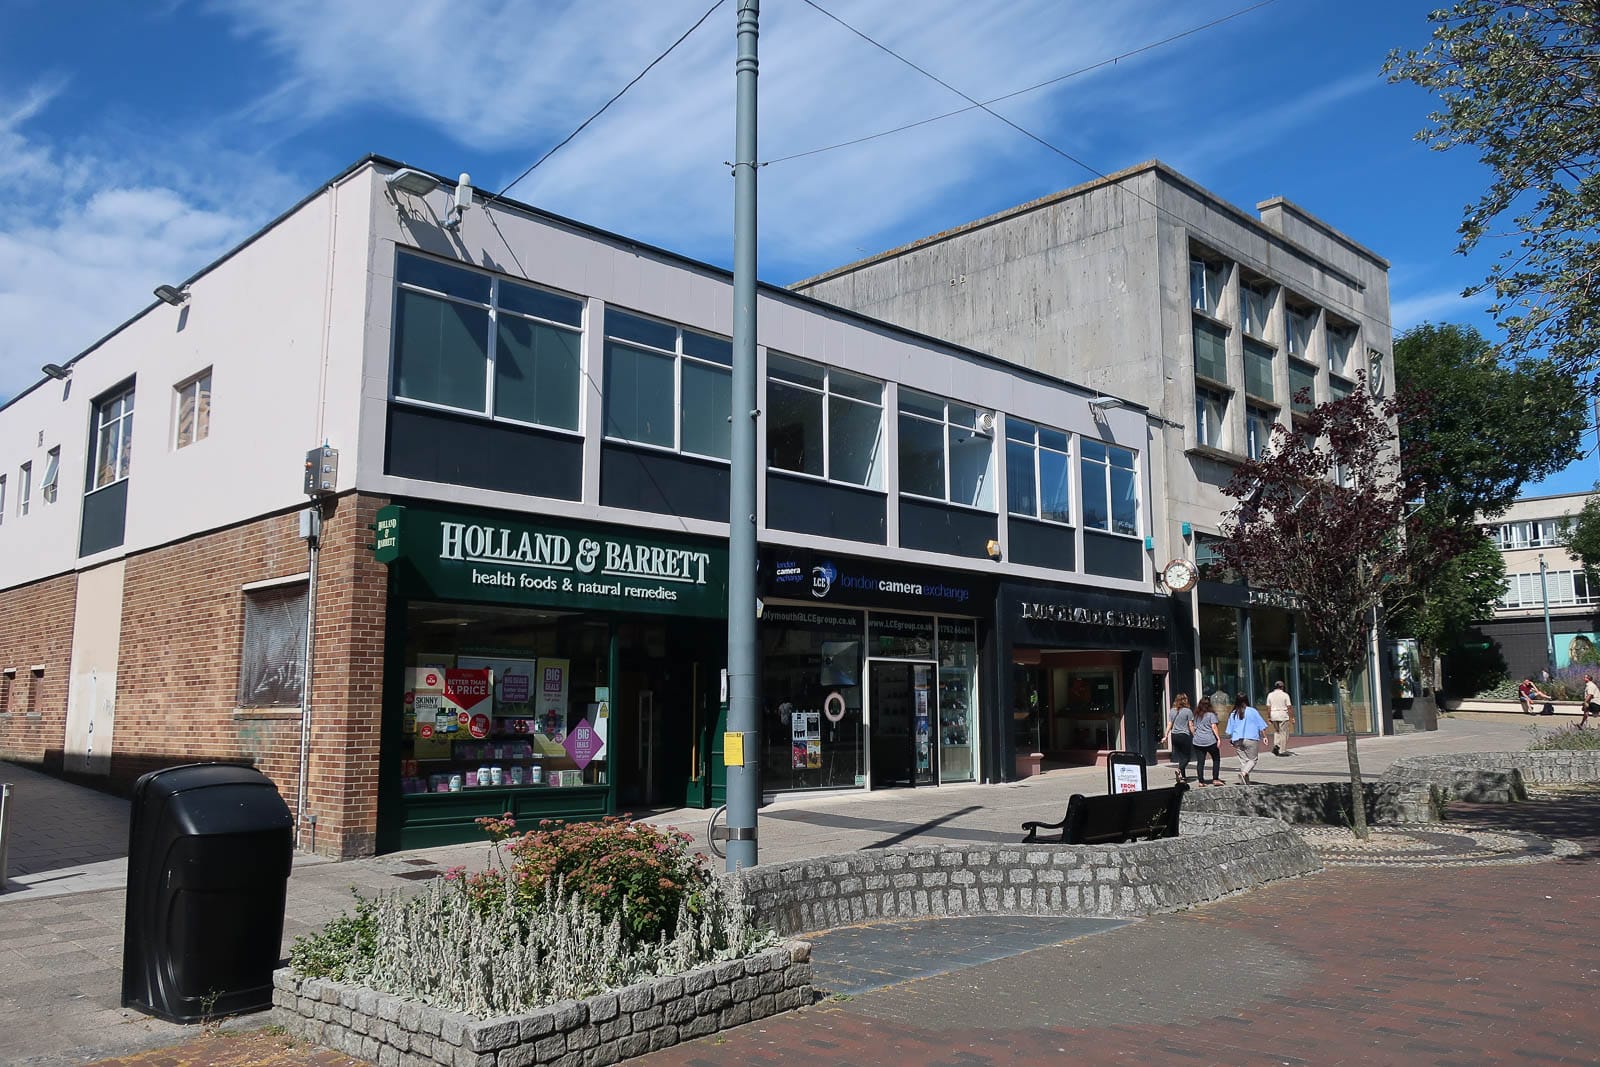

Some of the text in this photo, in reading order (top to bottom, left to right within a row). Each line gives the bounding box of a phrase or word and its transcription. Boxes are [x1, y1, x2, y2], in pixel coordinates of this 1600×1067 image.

[440, 521, 710, 584] HOLLAND & BARRETT
[776, 567, 801, 576] camera
[472, 568, 677, 601] health foods & natural remedies
[813, 576, 826, 588] LCE
[546, 668, 560, 681] BIG
[457, 685, 486, 695] PRICE
[415, 696, 438, 705] SKINNY
[577, 728, 590, 739] BIG
